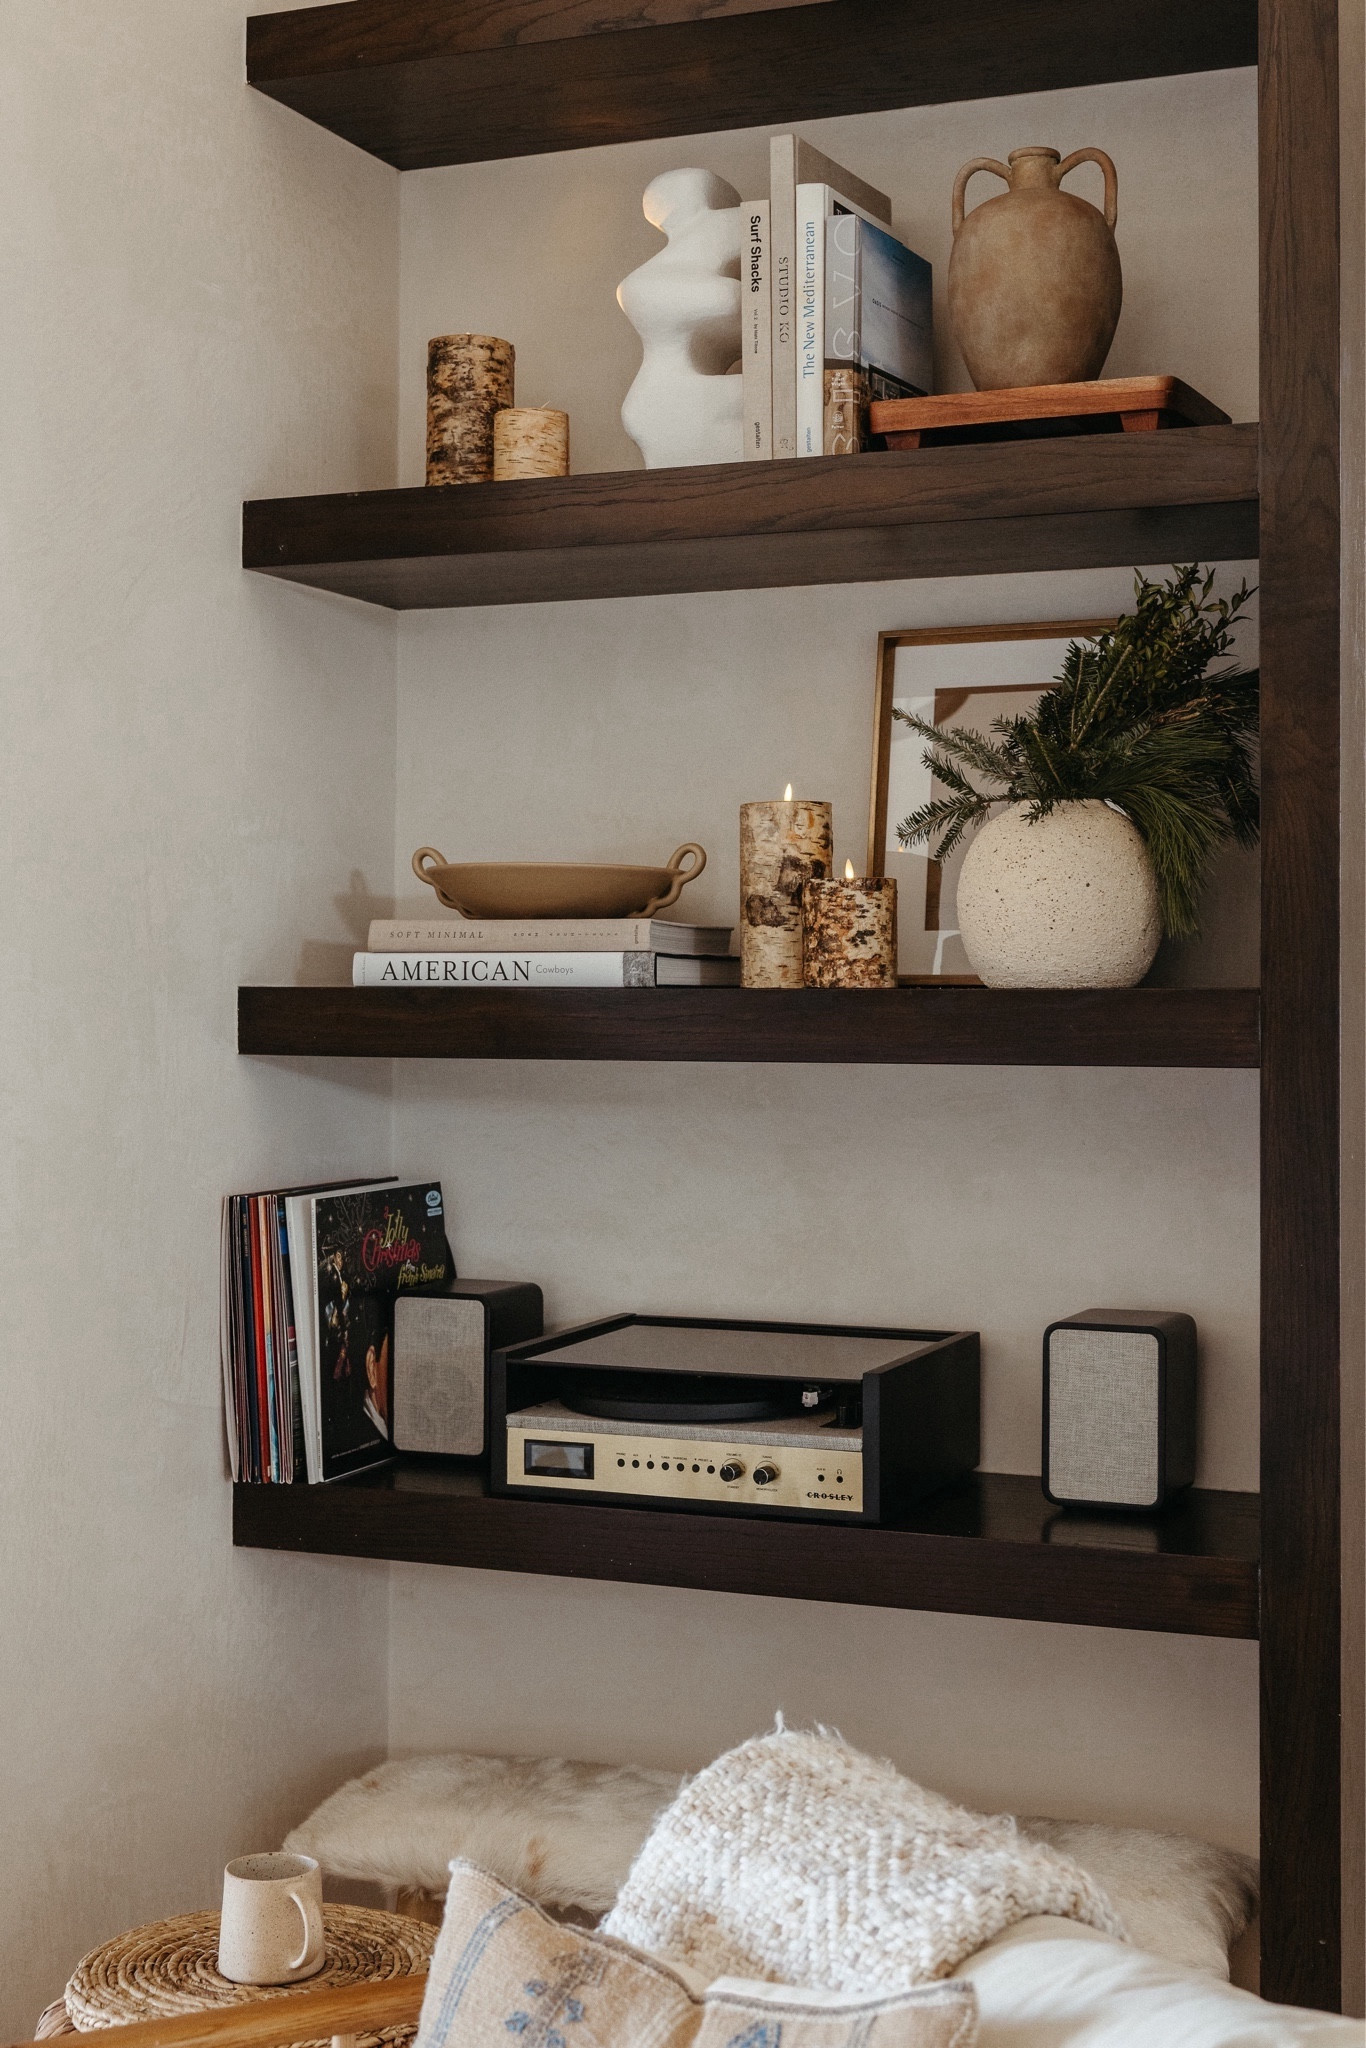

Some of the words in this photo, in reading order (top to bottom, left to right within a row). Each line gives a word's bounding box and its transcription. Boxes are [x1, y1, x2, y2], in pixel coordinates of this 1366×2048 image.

[750, 215, 762, 243] Surf
[750, 246, 762, 293] Shacks
[803, 221, 815, 319] Mediterranean
[778, 256, 789, 316] STUDIO
[803, 321, 815, 350] New
[803, 353, 815, 379] The
[389, 931, 421, 939] SOFT
[428, 931, 484, 939] MINIMAL
[379, 960, 532, 982] AMERICAN
[535, 964, 574, 976] Cowboys
[380, 1209, 409, 1249] Jolly
[362, 1228, 421, 1272] Christmas
[806, 1491, 854, 1501] CROSLEY
